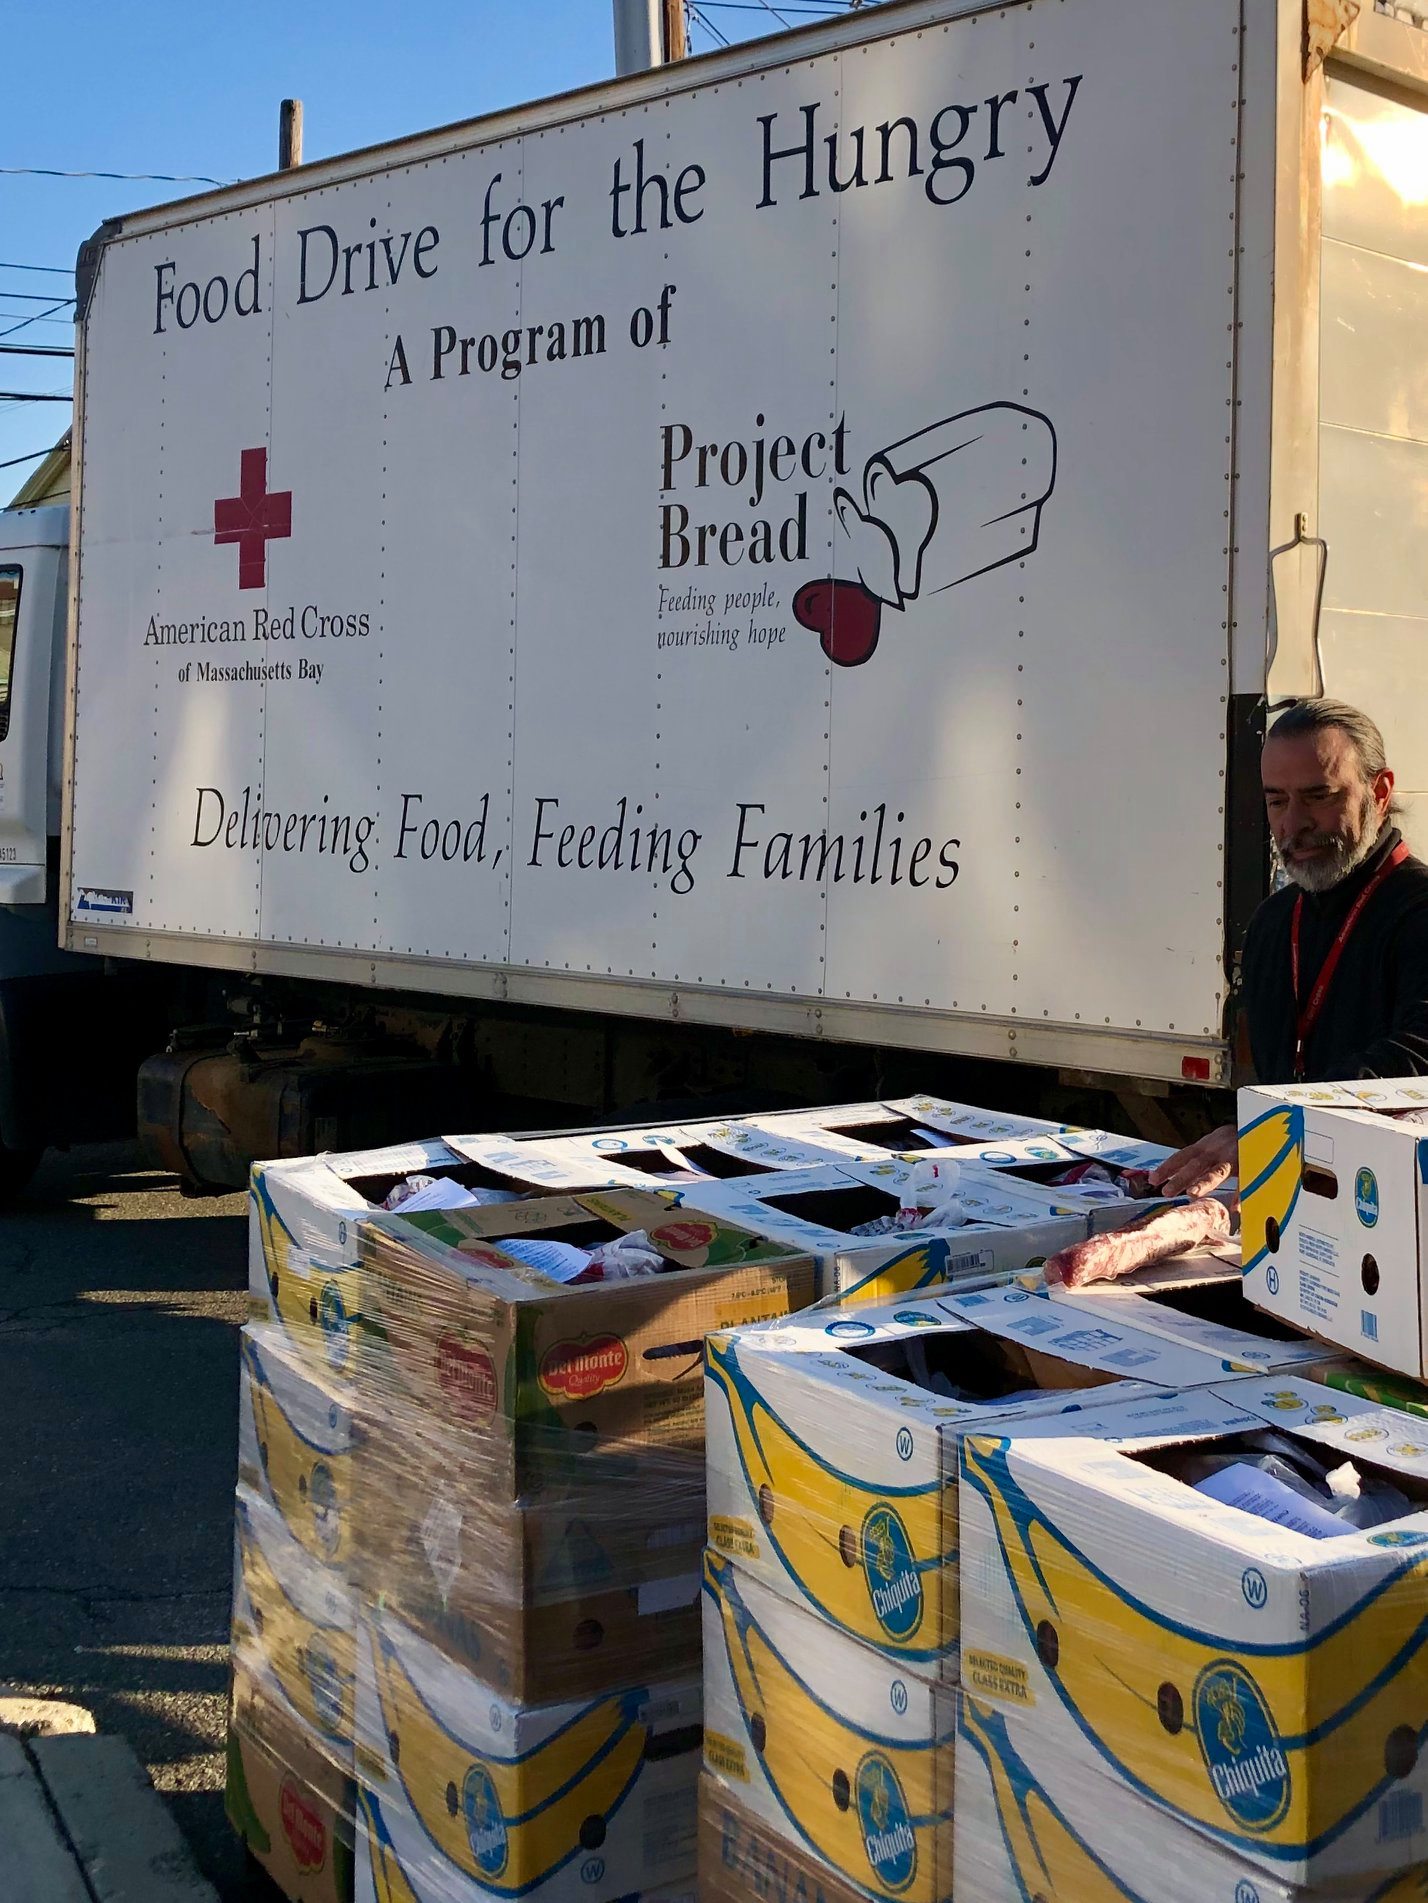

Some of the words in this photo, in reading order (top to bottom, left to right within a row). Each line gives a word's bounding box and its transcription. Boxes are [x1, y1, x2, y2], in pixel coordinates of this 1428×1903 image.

[153, 234, 262, 335] Food
[297, 217, 440, 305] Drive
[478, 173, 565, 267] for
[609, 138, 706, 239] the
[755, 73, 1084, 208] Hungry
[385, 335, 413, 388] A
[430, 308, 606, 381] Program
[630, 285, 677, 347] of
[658, 409, 851, 506] Project
[657, 491, 809, 569] Bread
[658, 585, 717, 616] Feeding
[723, 582, 780, 613] people,
[143, 614, 246, 644] American
[252, 607, 296, 641] Red
[301, 605, 371, 638] Cross
[657, 620, 740, 651] nourishing
[747, 619, 787, 648] hope
[178, 661, 191, 682] of
[196, 658, 292, 682] Massachusetts
[298, 658, 324, 684] Bay
[190, 786, 376, 873] Delivering
[393, 793, 504, 870] Food,
[527, 796, 703, 895] Feeding
[726, 802, 961, 890] Families
[574, 1350, 623, 1373] Monte
[872, 1569, 921, 1619] Chiquita
[1212, 1744, 1287, 1800] Chiquita
[866, 1822, 915, 1866] Chiquita
